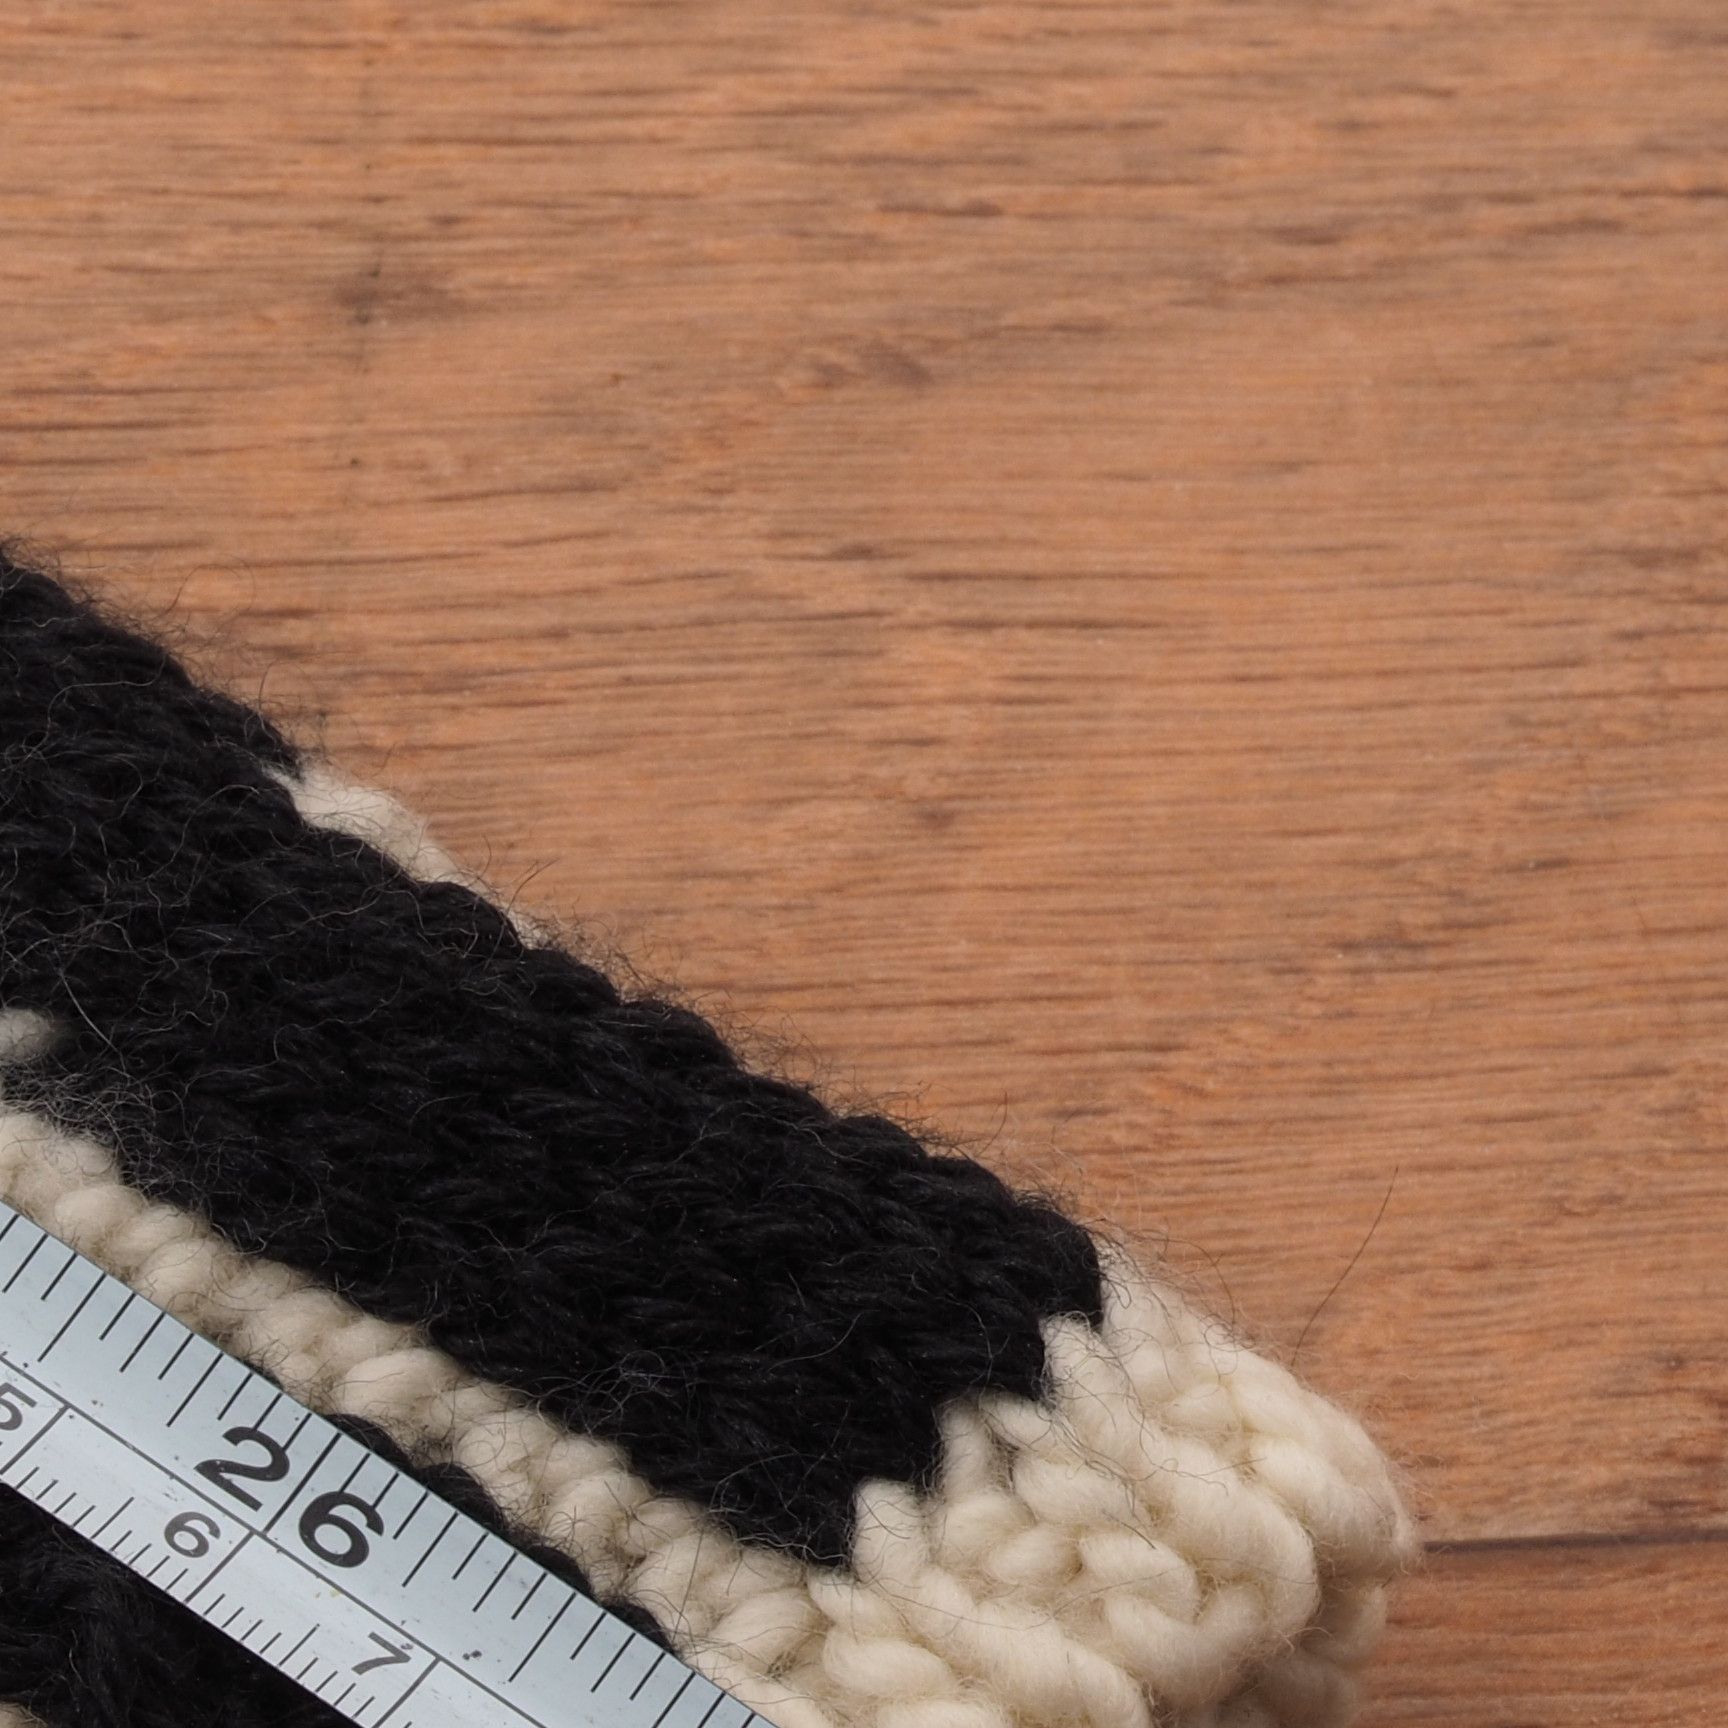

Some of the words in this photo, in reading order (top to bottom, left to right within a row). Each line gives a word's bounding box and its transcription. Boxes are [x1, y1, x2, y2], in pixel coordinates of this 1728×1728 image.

[194, 1425, 386, 1569] 26
[163, 1511, 221, 1559] 6
[348, 1632, 413, 1676] 7
